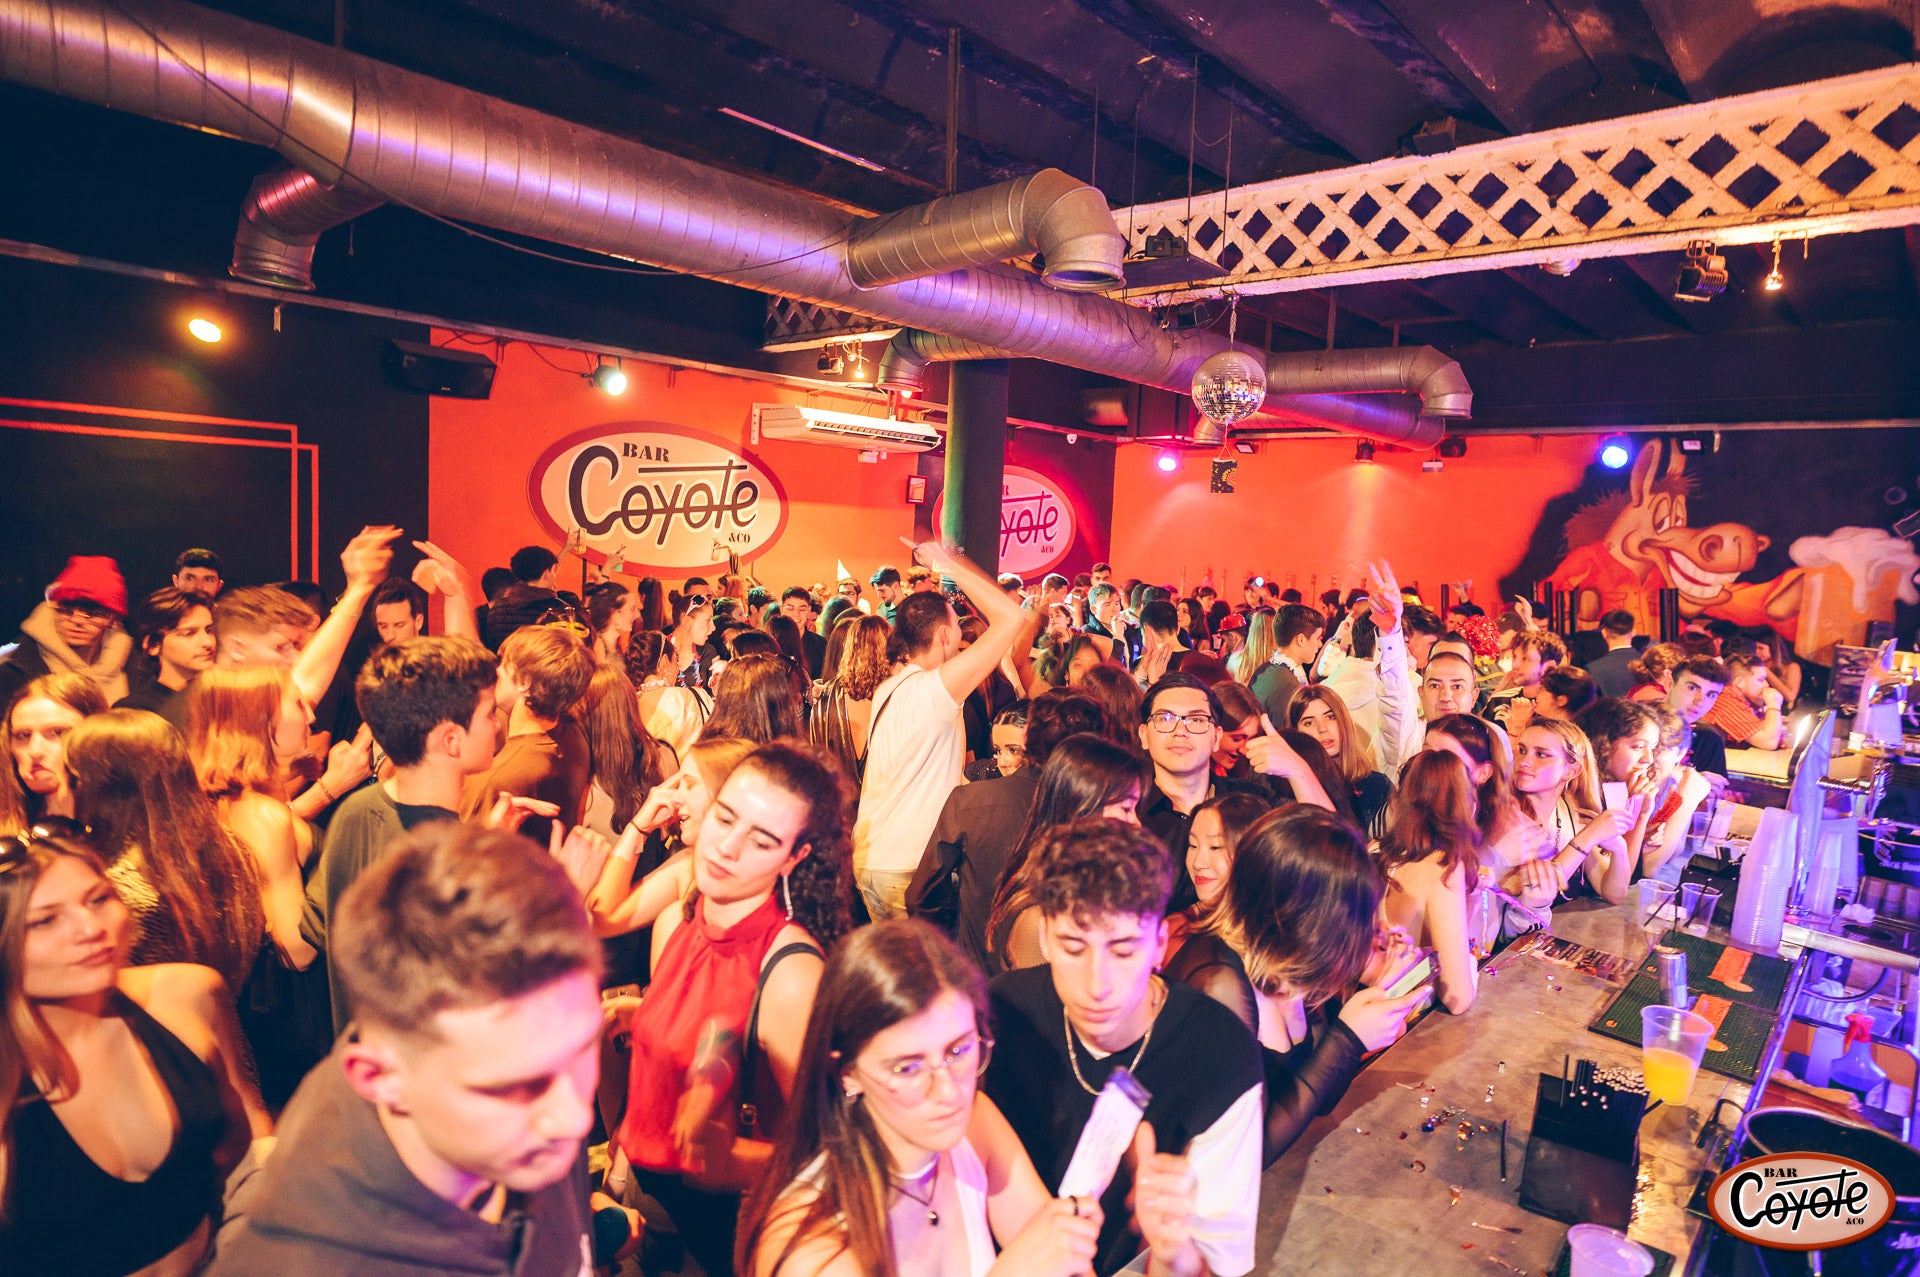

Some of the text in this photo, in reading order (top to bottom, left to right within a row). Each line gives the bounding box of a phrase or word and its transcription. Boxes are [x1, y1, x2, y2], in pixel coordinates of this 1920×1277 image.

[622, 442, 670, 462] BAR
[568, 445, 758, 546] Coyote
[728, 532, 751, 544] &CO
[1000, 490, 1059, 557] yote
